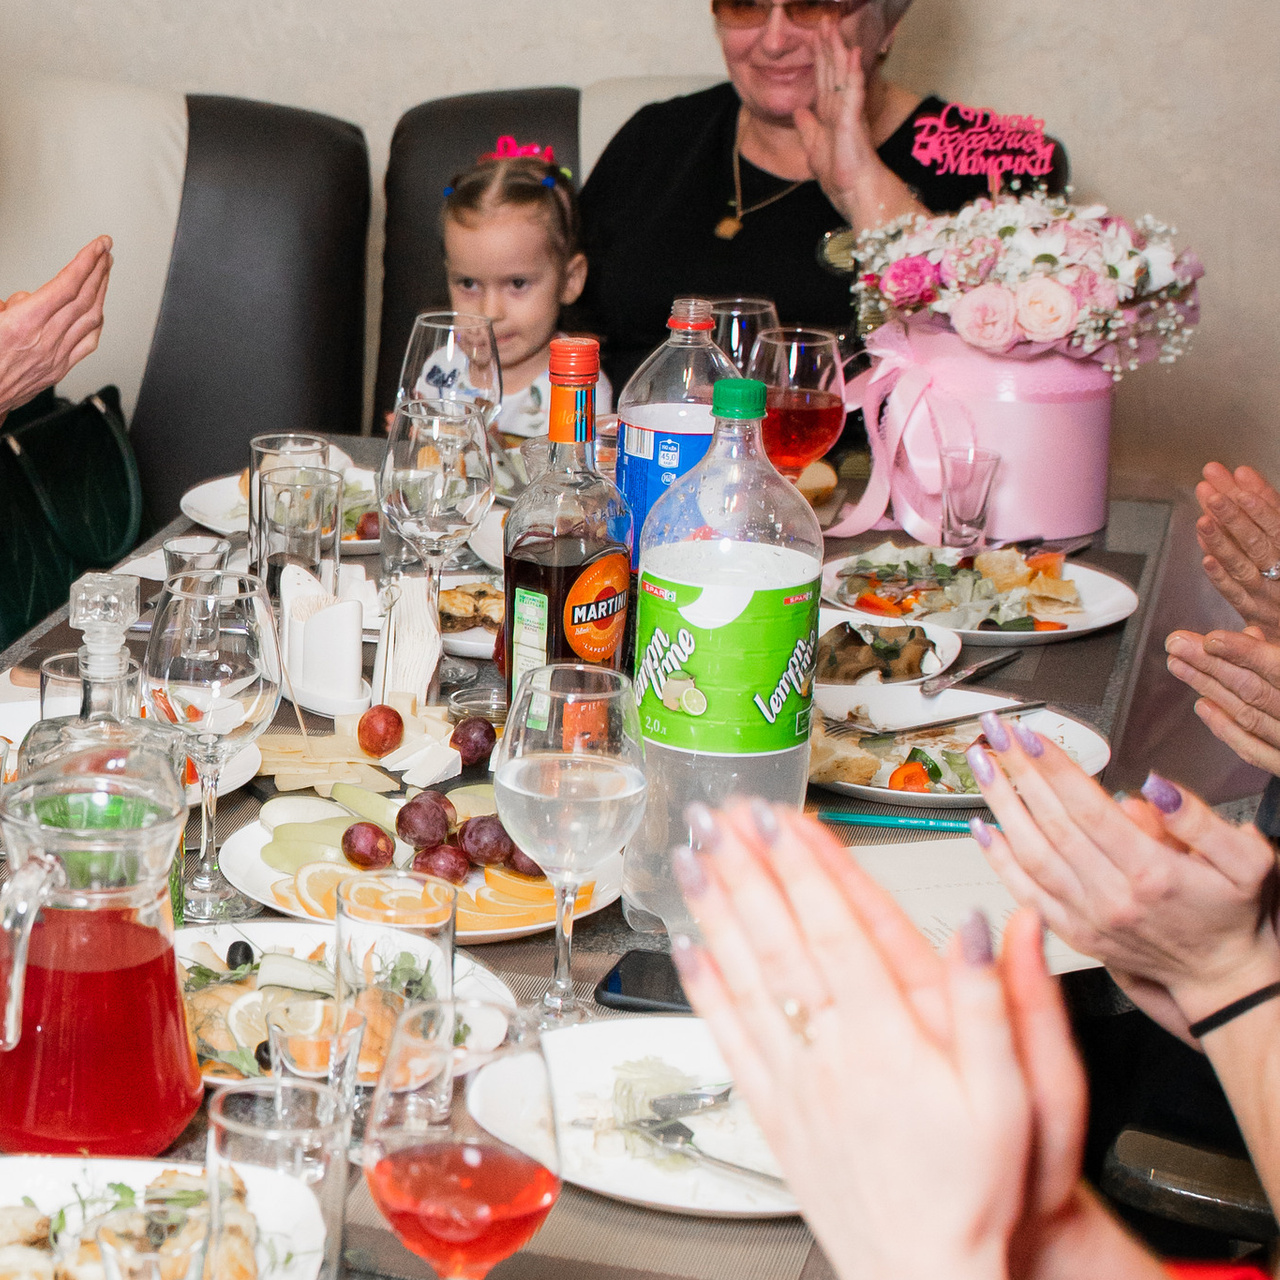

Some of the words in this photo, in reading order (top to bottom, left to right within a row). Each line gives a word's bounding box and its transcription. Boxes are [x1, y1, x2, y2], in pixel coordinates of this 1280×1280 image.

[644, 583, 665, 598] SPAR
[573, 590, 627, 624] MARTINI
[645, 715, 660, 734] 2,0
